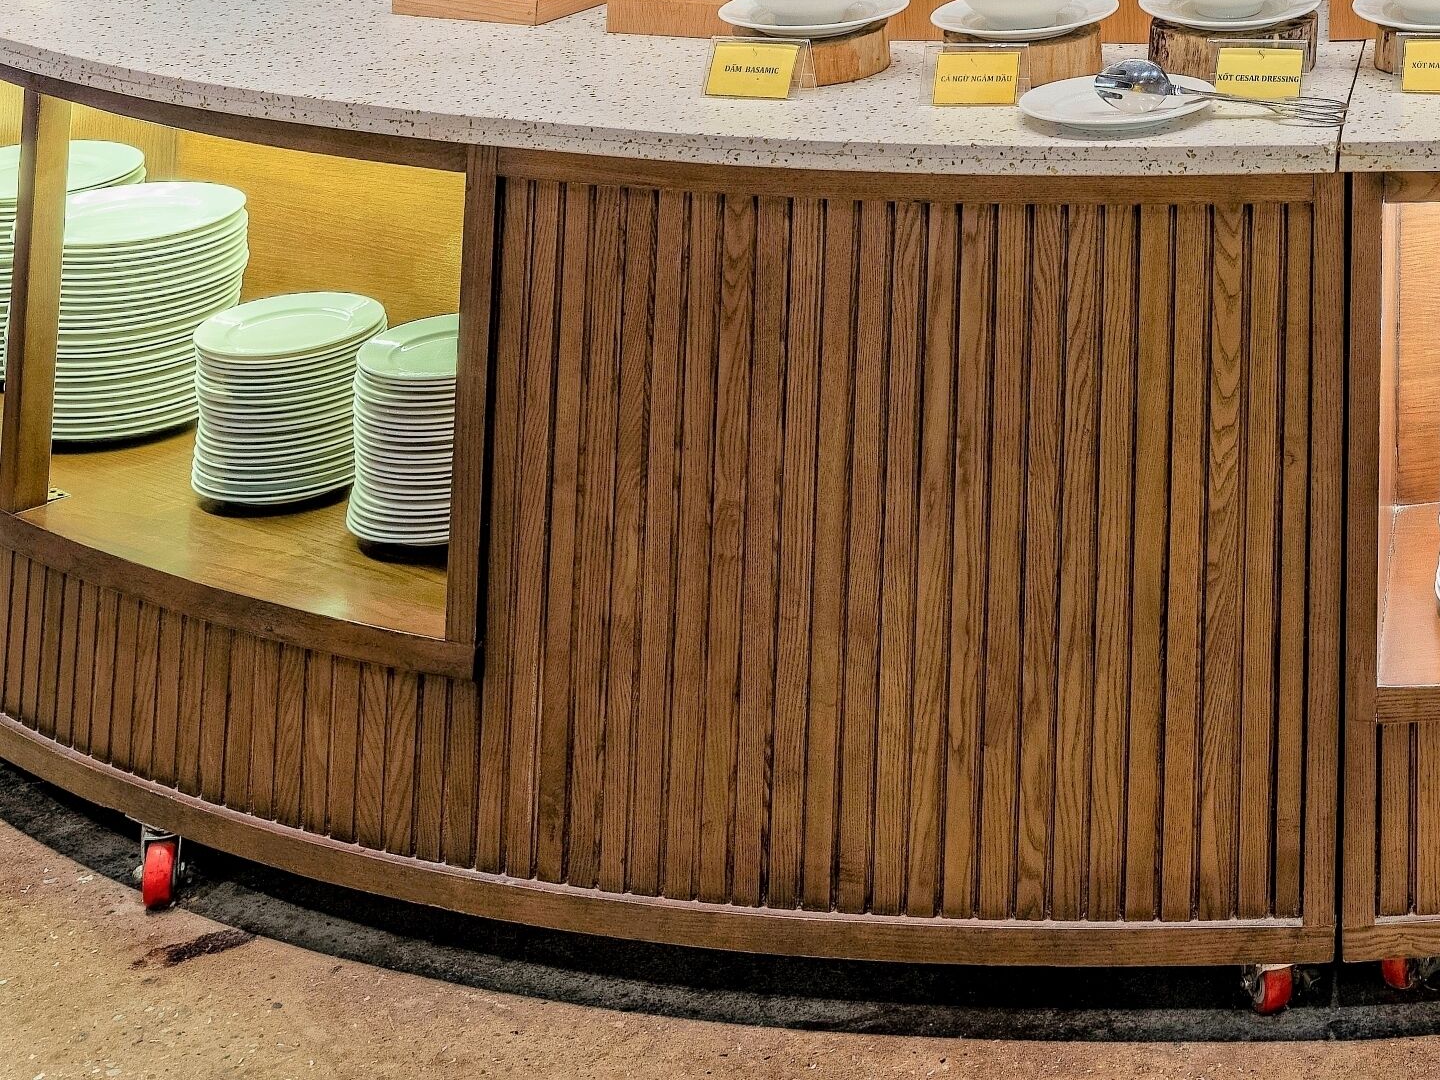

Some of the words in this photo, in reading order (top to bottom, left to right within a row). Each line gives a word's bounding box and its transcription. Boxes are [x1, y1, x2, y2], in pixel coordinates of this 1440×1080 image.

[745, 65, 780, 75] BASAMIC
[1235, 74, 1260, 82] CESAR
[1261, 74, 1300, 83] DRESSING
